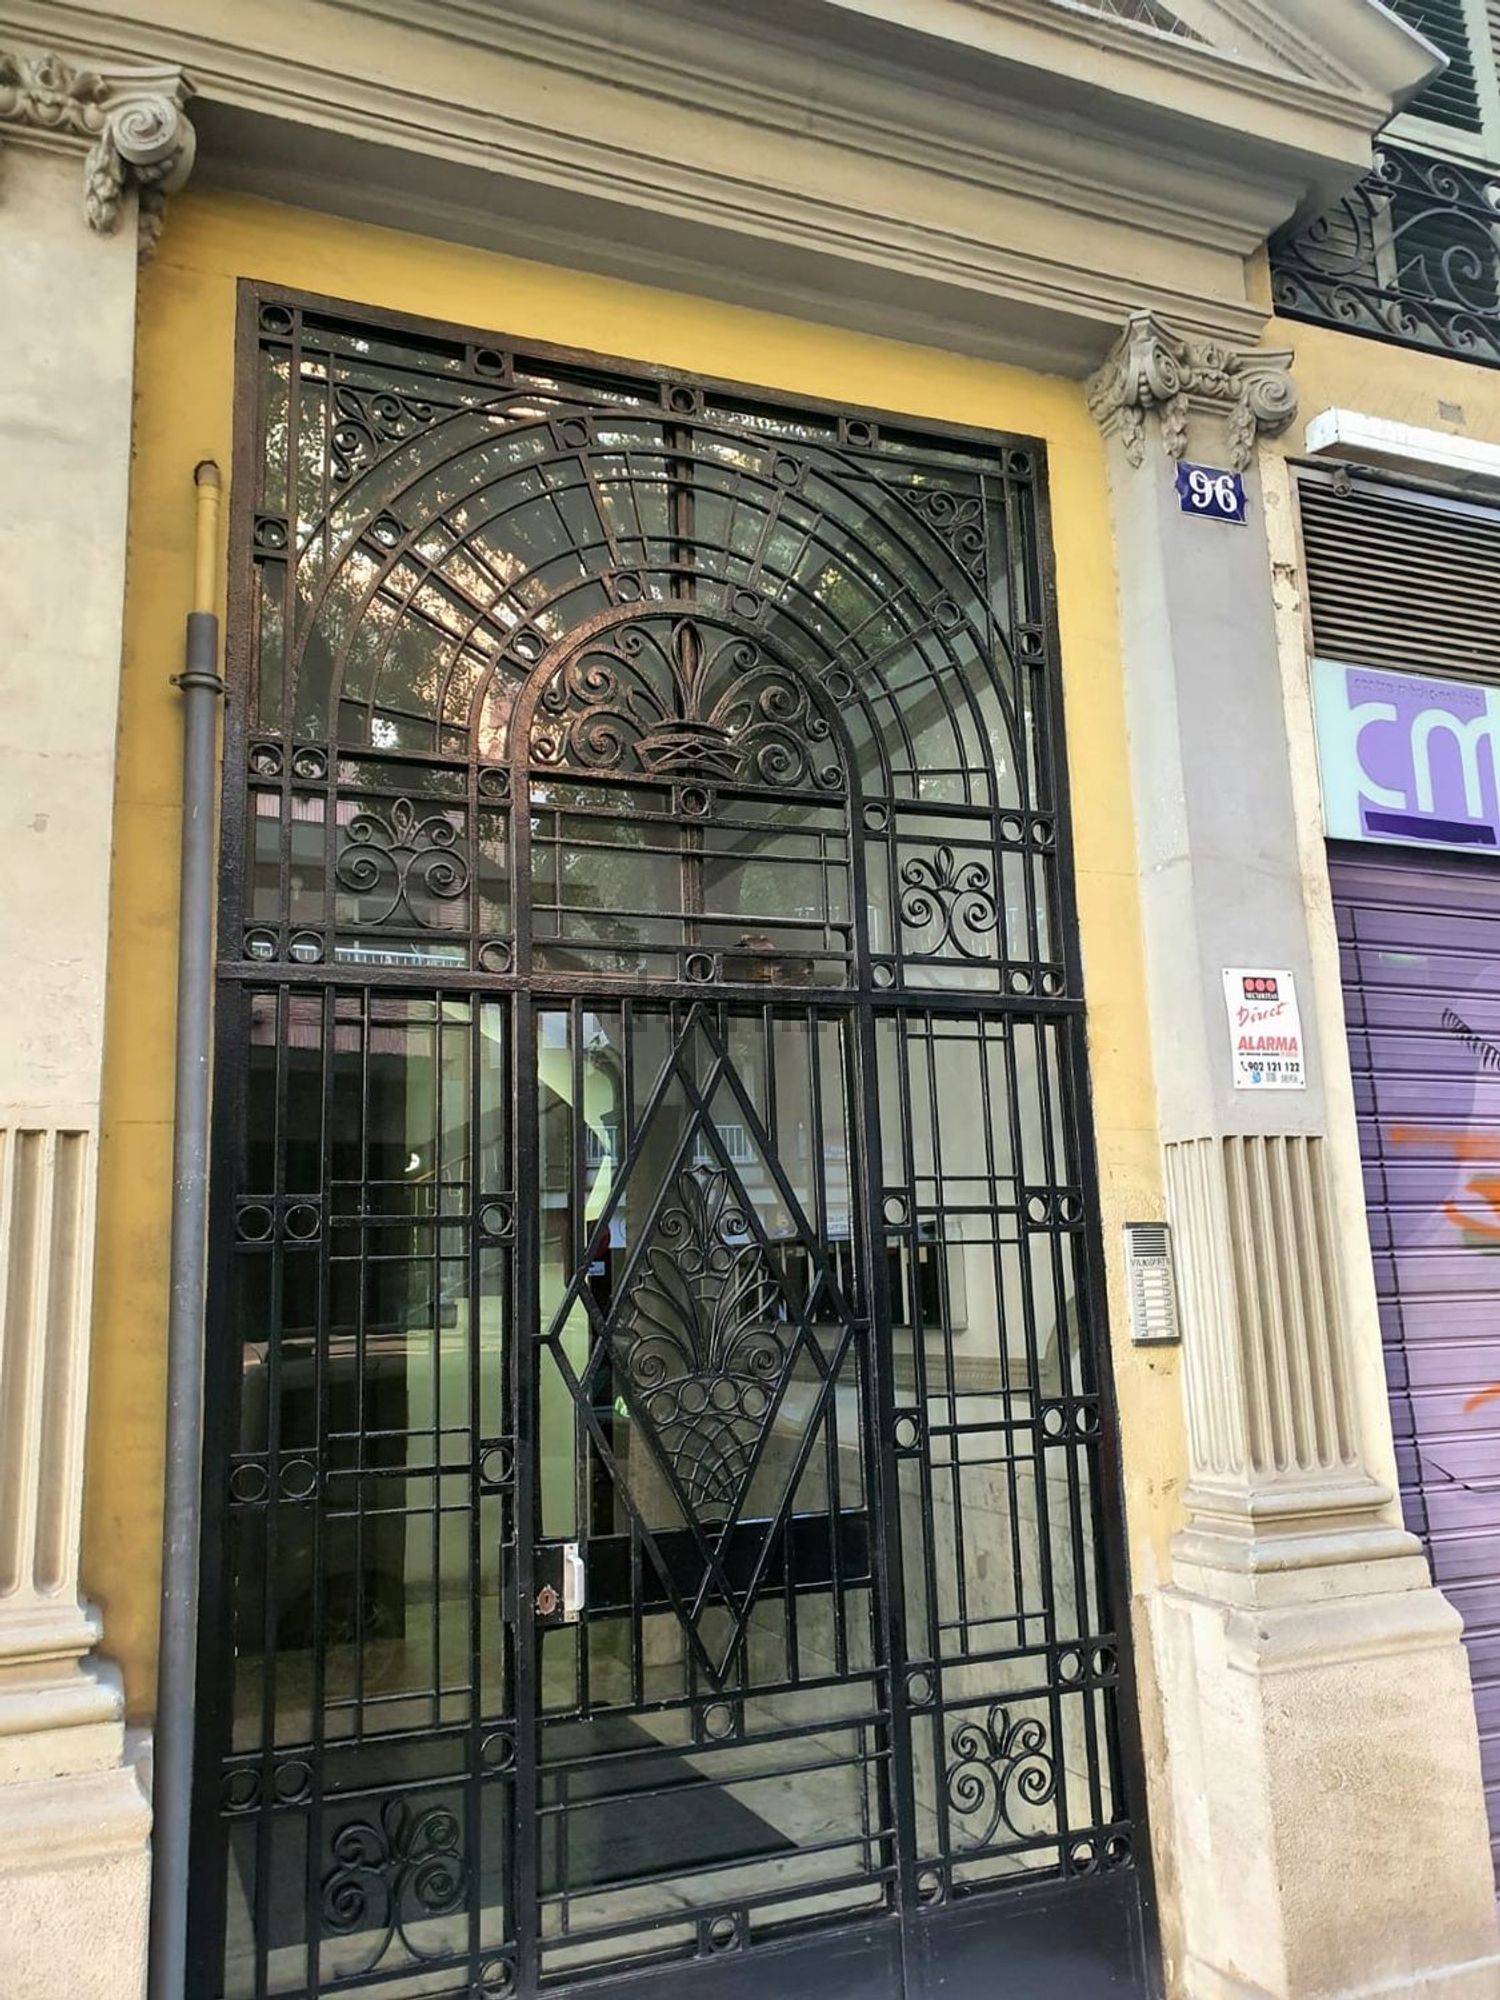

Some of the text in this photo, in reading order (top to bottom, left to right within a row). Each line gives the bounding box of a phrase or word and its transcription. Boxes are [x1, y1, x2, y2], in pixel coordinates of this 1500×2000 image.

[1189, 470, 1237, 513] 96
[1236, 1002, 1289, 1027] Direct
[1238, 1035, 1298, 1051] ALARMA
[1248, 1061, 1300, 1072] 902 121 122
